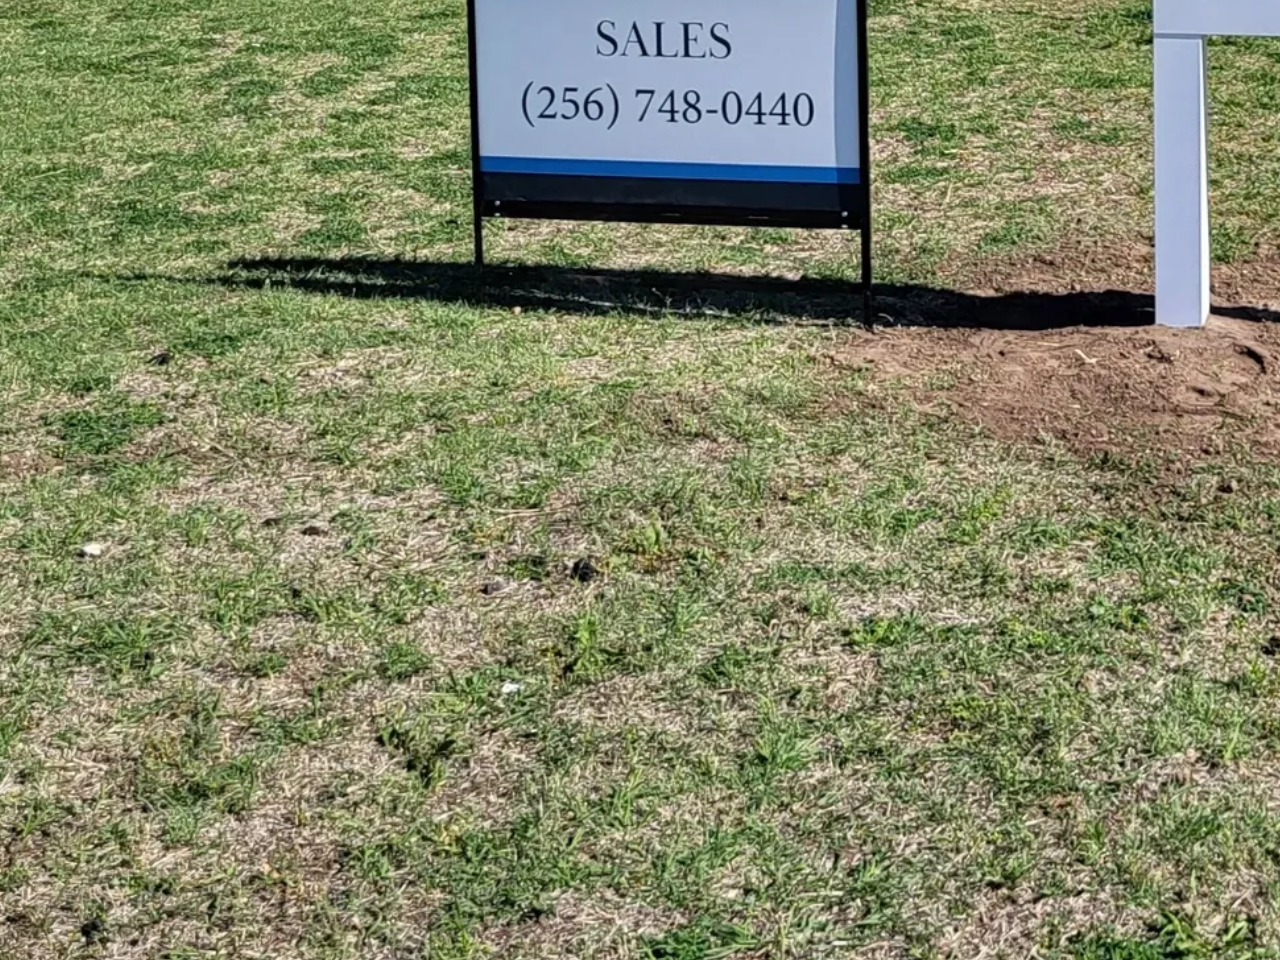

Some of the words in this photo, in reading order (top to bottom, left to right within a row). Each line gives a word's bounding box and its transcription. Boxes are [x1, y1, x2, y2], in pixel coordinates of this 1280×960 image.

[596, 19, 732, 60] SALES
[521, 81, 620, 130] (256)
[634, 88, 815, 127] 748-0440
